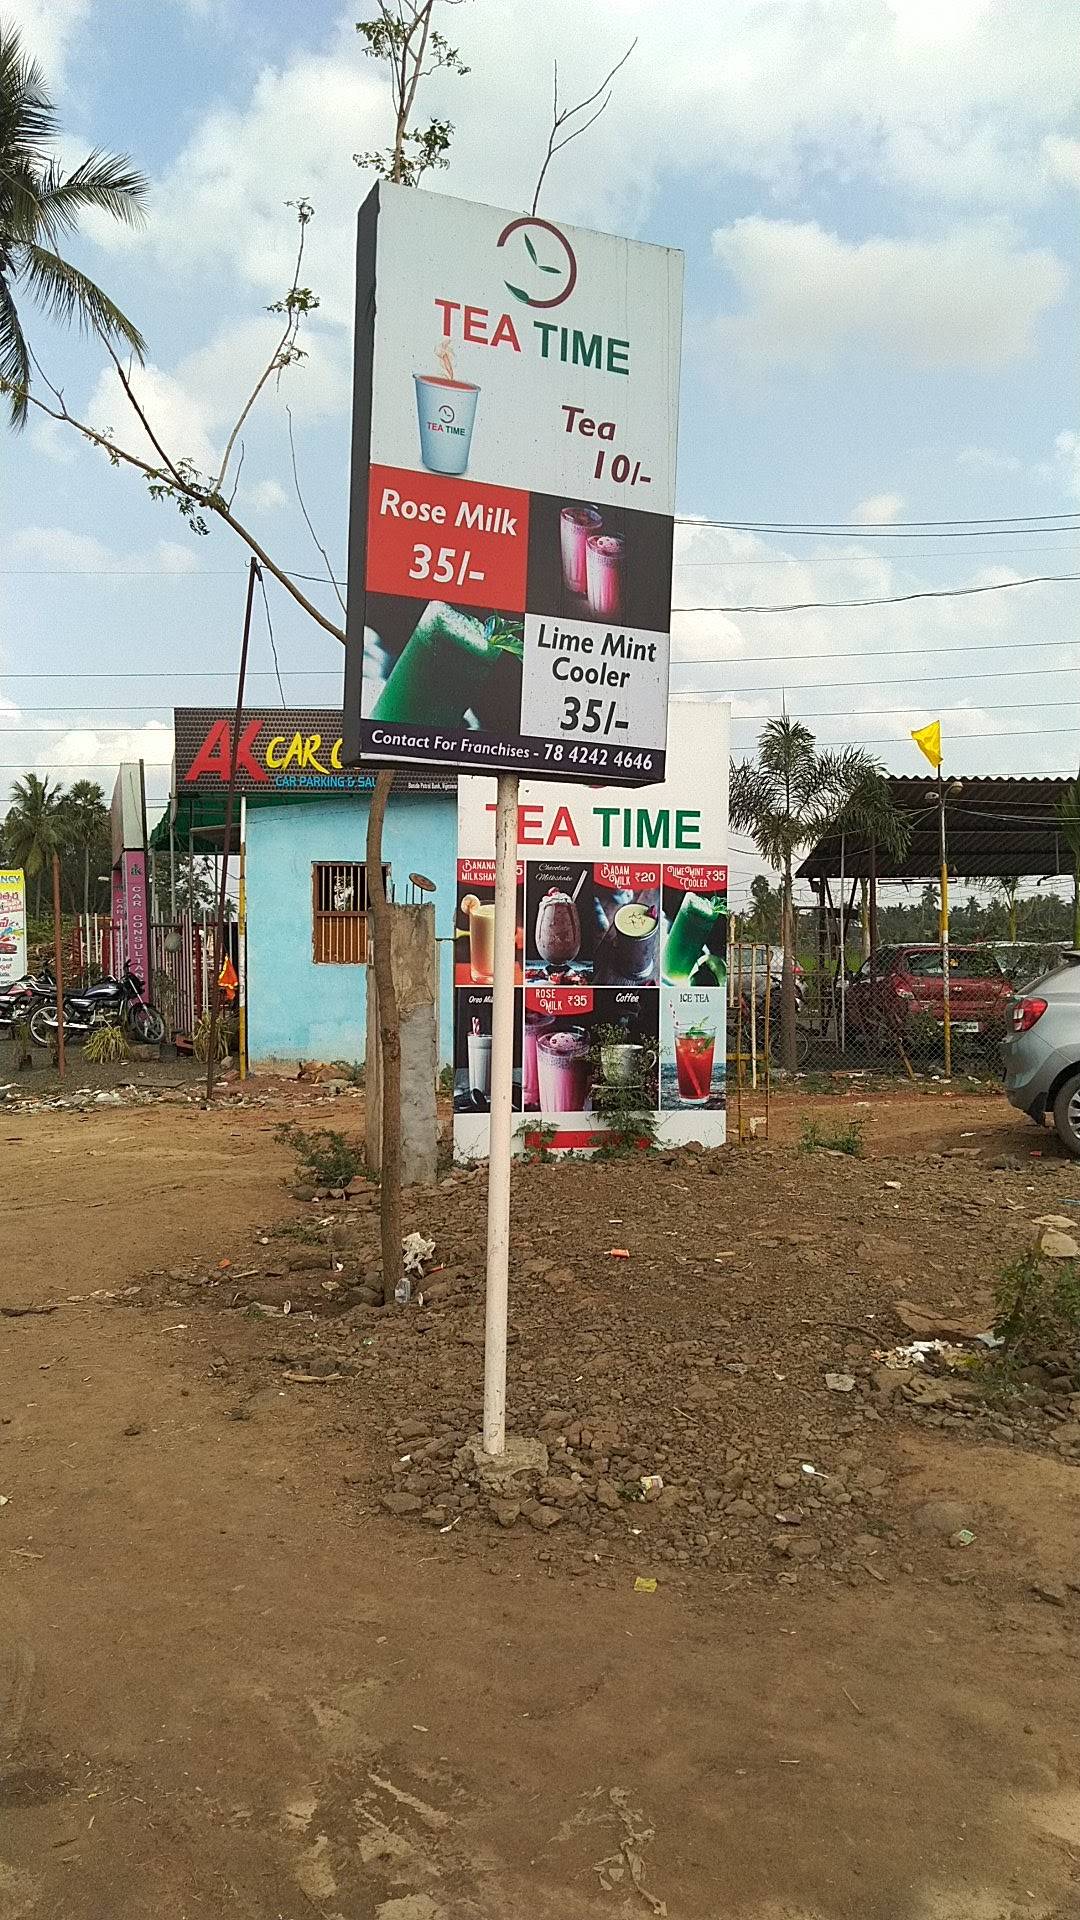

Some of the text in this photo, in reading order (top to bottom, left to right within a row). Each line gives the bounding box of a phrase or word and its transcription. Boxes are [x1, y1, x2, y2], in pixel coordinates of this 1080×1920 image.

[434, 298, 630, 376] TEA TIME
[427, 421, 466, 436] TEA TIME
[561, 404, 616, 441] Tea
[594, 450, 652, 486] 10/-
[380, 488, 518, 537] Rose Milk
[408, 543, 485, 586] 35/-
[537, 623, 657, 663] Lime Mint
[551, 656, 630, 688] Cooler
[559, 696, 629, 735] 35/-
[266, 731, 330, 775] CAR
[371, 729, 430, 749] Contact
[434, 736, 457, 751] For
[461, 738, 530, 759] Franchises
[544, 743, 564, 761] 78
[568, 746, 608, 766] 4242
[613, 751, 653, 770] 4646
[276, 776, 296, 787] CAR
[300, 776, 345, 787] PARKING
[593, 807, 701, 850] TIME
[462, 860, 496, 872] BANANA
[538, 863, 571, 872] Chocolate
[601, 863, 630, 878] BADAM
[461, 872, 496, 881] MILKSHAK
[536, 872, 573, 881] Milkshake
[609, 873, 631, 889] MILK
[681, 877, 708, 890] COOLER
[132, 886, 142, 907] CAR
[132, 915, 144, 980] CONSULTAN
[535, 989, 556, 998] ROSE
[615, 992, 640, 1003] Coffee
[680, 993, 710, 1003] ICE TEA
[540, 999, 563, 1014] MILK
